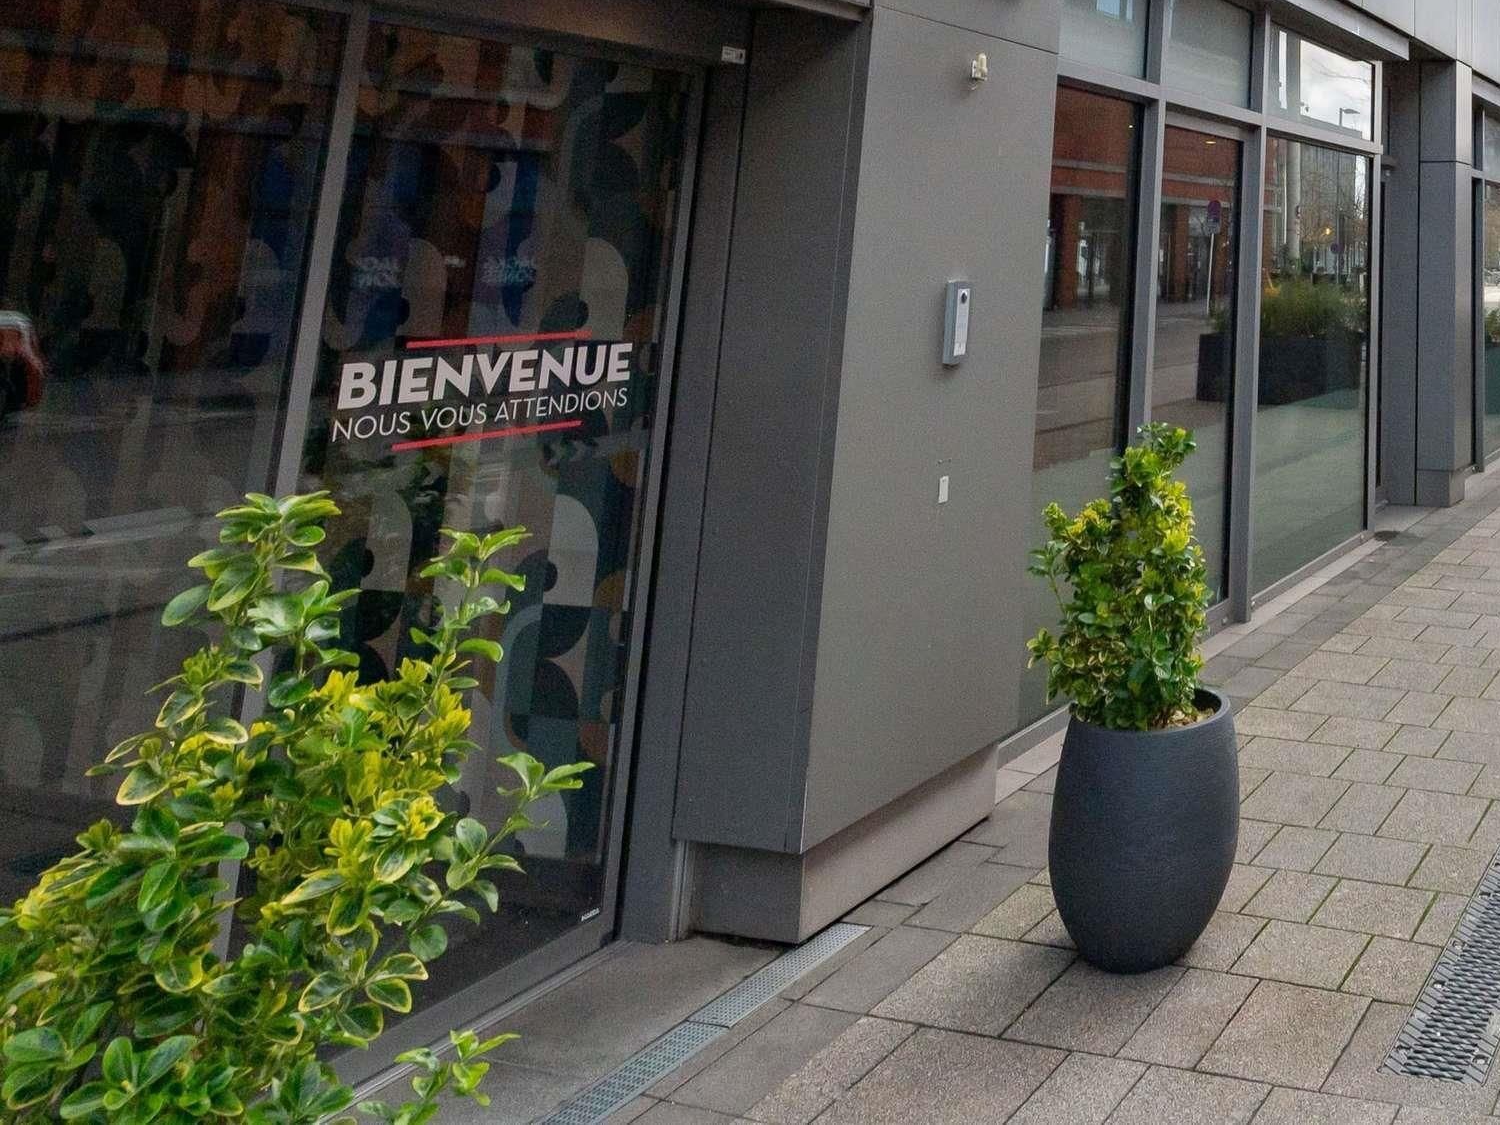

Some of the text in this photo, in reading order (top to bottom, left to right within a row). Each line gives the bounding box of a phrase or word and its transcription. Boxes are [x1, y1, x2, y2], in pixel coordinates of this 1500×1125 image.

[337, 342, 633, 410] BIENVENUE
[332, 387, 628, 442] NOUS VOUS ATTENDIONS
